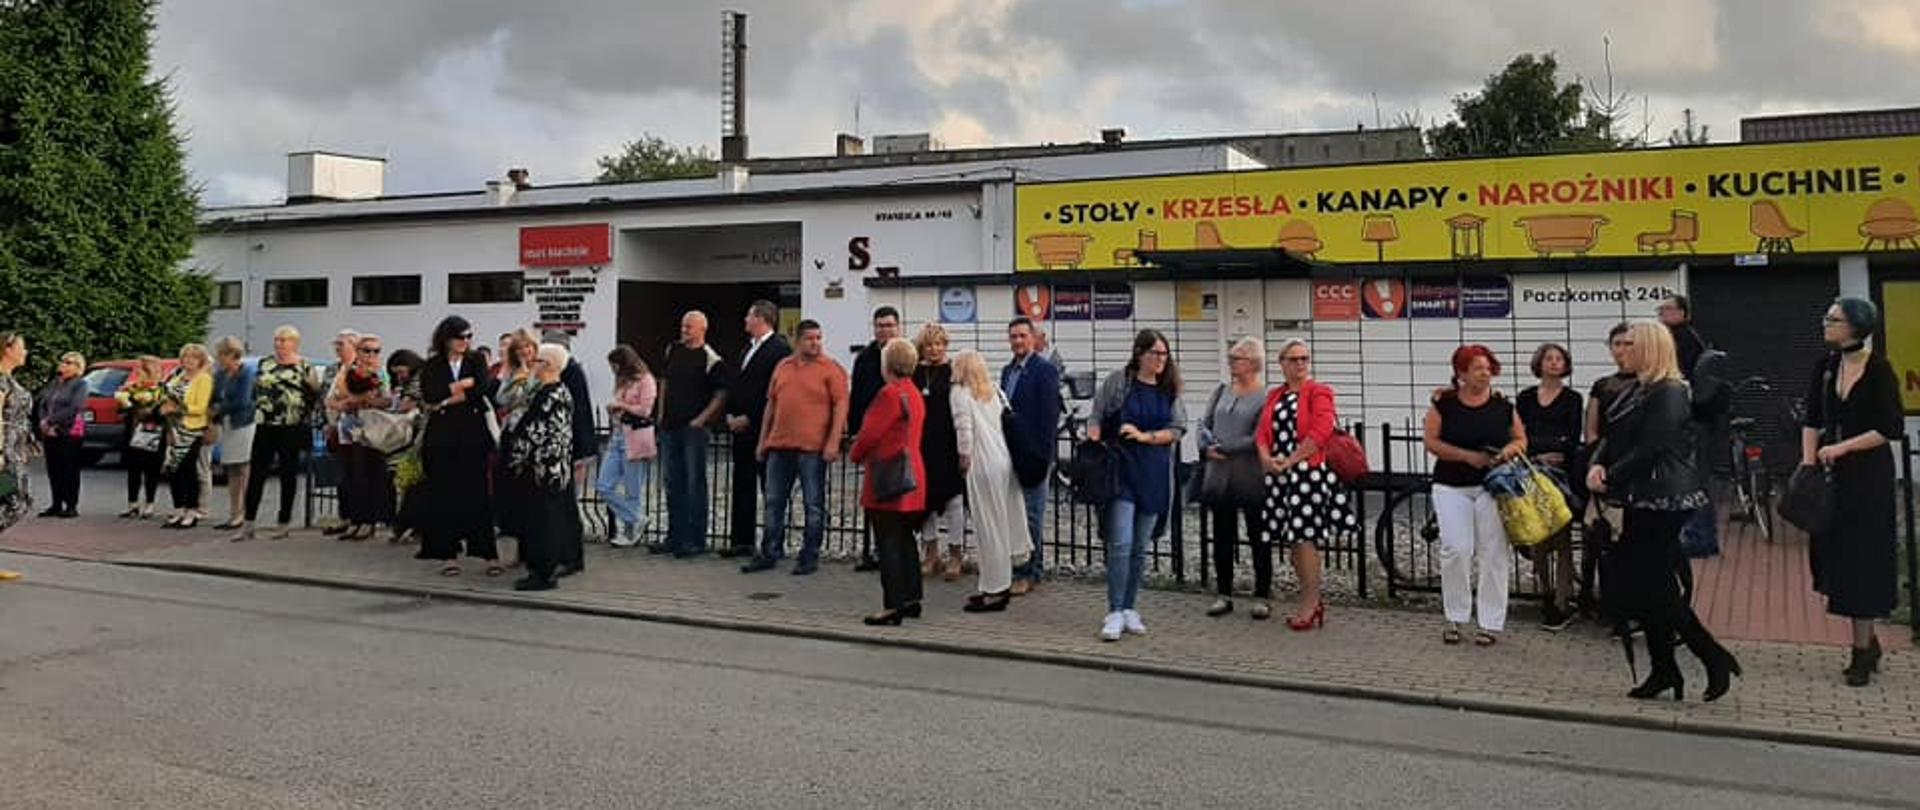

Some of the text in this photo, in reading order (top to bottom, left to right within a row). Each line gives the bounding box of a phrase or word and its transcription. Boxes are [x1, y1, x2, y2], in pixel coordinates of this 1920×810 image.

[1058, 165, 1882, 225] STOŁY KRZESŁA KANAPY NAROŻNIKI KUCHNIE
[1316, 284, 1353, 298] CCC
[1522, 288, 1631, 303] Paczkomat
